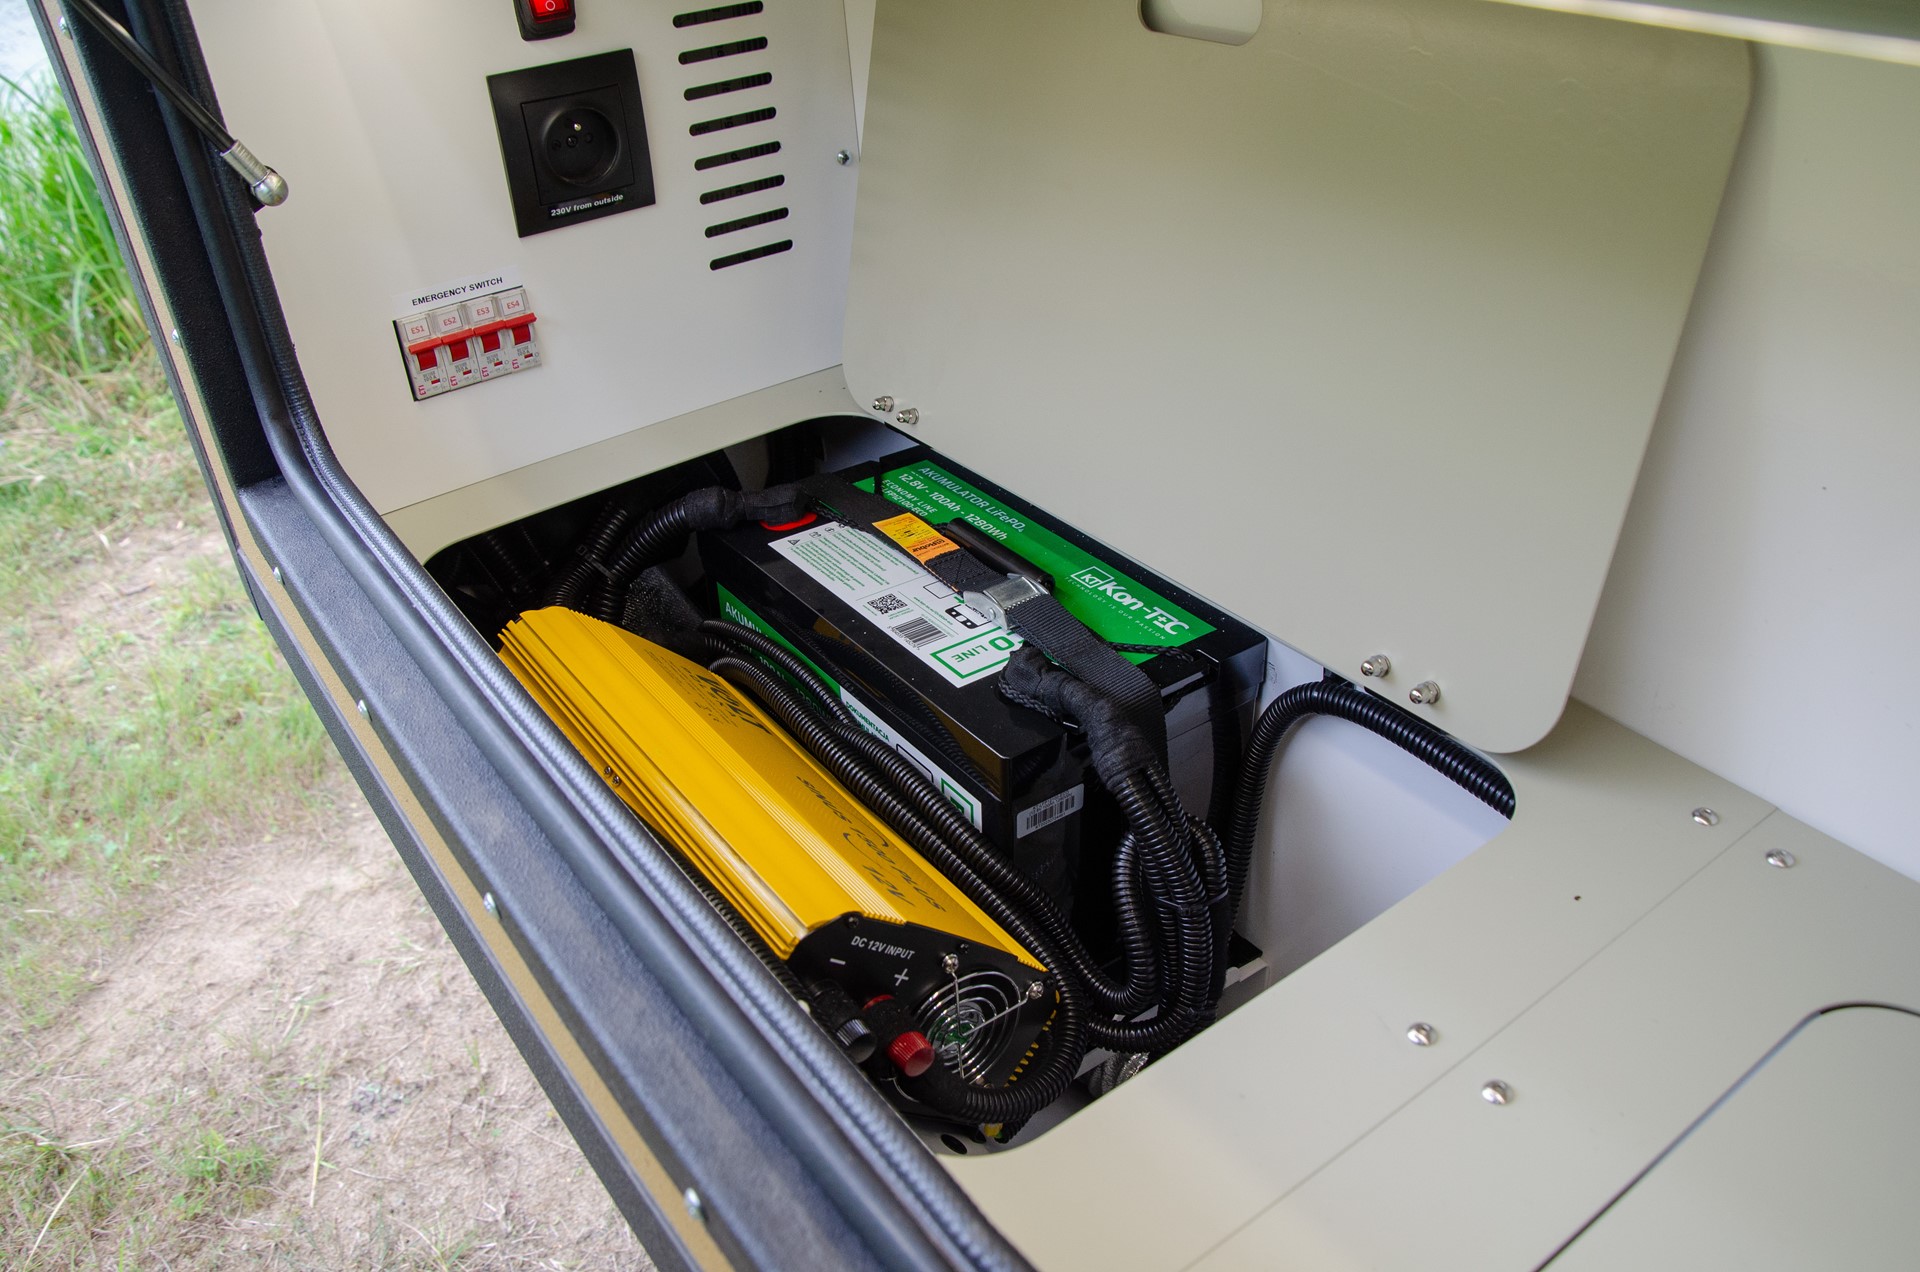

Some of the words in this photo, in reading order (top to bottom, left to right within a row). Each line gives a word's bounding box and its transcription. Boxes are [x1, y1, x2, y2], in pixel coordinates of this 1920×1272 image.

[551, 205, 572, 216] 230V
[573, 202, 592, 211] from
[593, 193, 624, 207] outside
[411, 286, 467, 306] EMERGENCY
[469, 276, 503, 291] SWITCH
[476, 306, 490, 316] ES3
[506, 300, 520, 310] ES4
[410, 325, 425, 335] ES1
[443, 318, 457, 327] ES2
[481, 366, 490, 378] ETI
[512, 358, 520, 369] ETI
[418, 384, 427, 396] ETI
[450, 375, 458, 387] ETI
[881, 479, 920, 501] ECONOMY
[917, 501, 938, 514] LINE
[917, 467, 989, 508] AKUMULATOR
[898, 473, 928, 490] 12.8V
[929, 491, 961, 512] 100Ah
[965, 513, 1008, 541] 1280Wh
[1065, 576, 1106, 603] TECHNOLOGY
[1118, 609, 1133, 620] OUR
[1135, 620, 1166, 640] PASSION
[1097, 581, 1190, 635] Kon-TEC
[951, 644, 988, 663] LINE
[845, 701, 889, 742] DOKUMENTACJA
[796, 775, 852, 824] SINUS
[890, 864, 947, 912] PLUS
[862, 864, 916, 907] 12V
[850, 935, 868, 948] DC
[867, 940, 887, 953] 12V
[884, 945, 916, 960] INPUT
